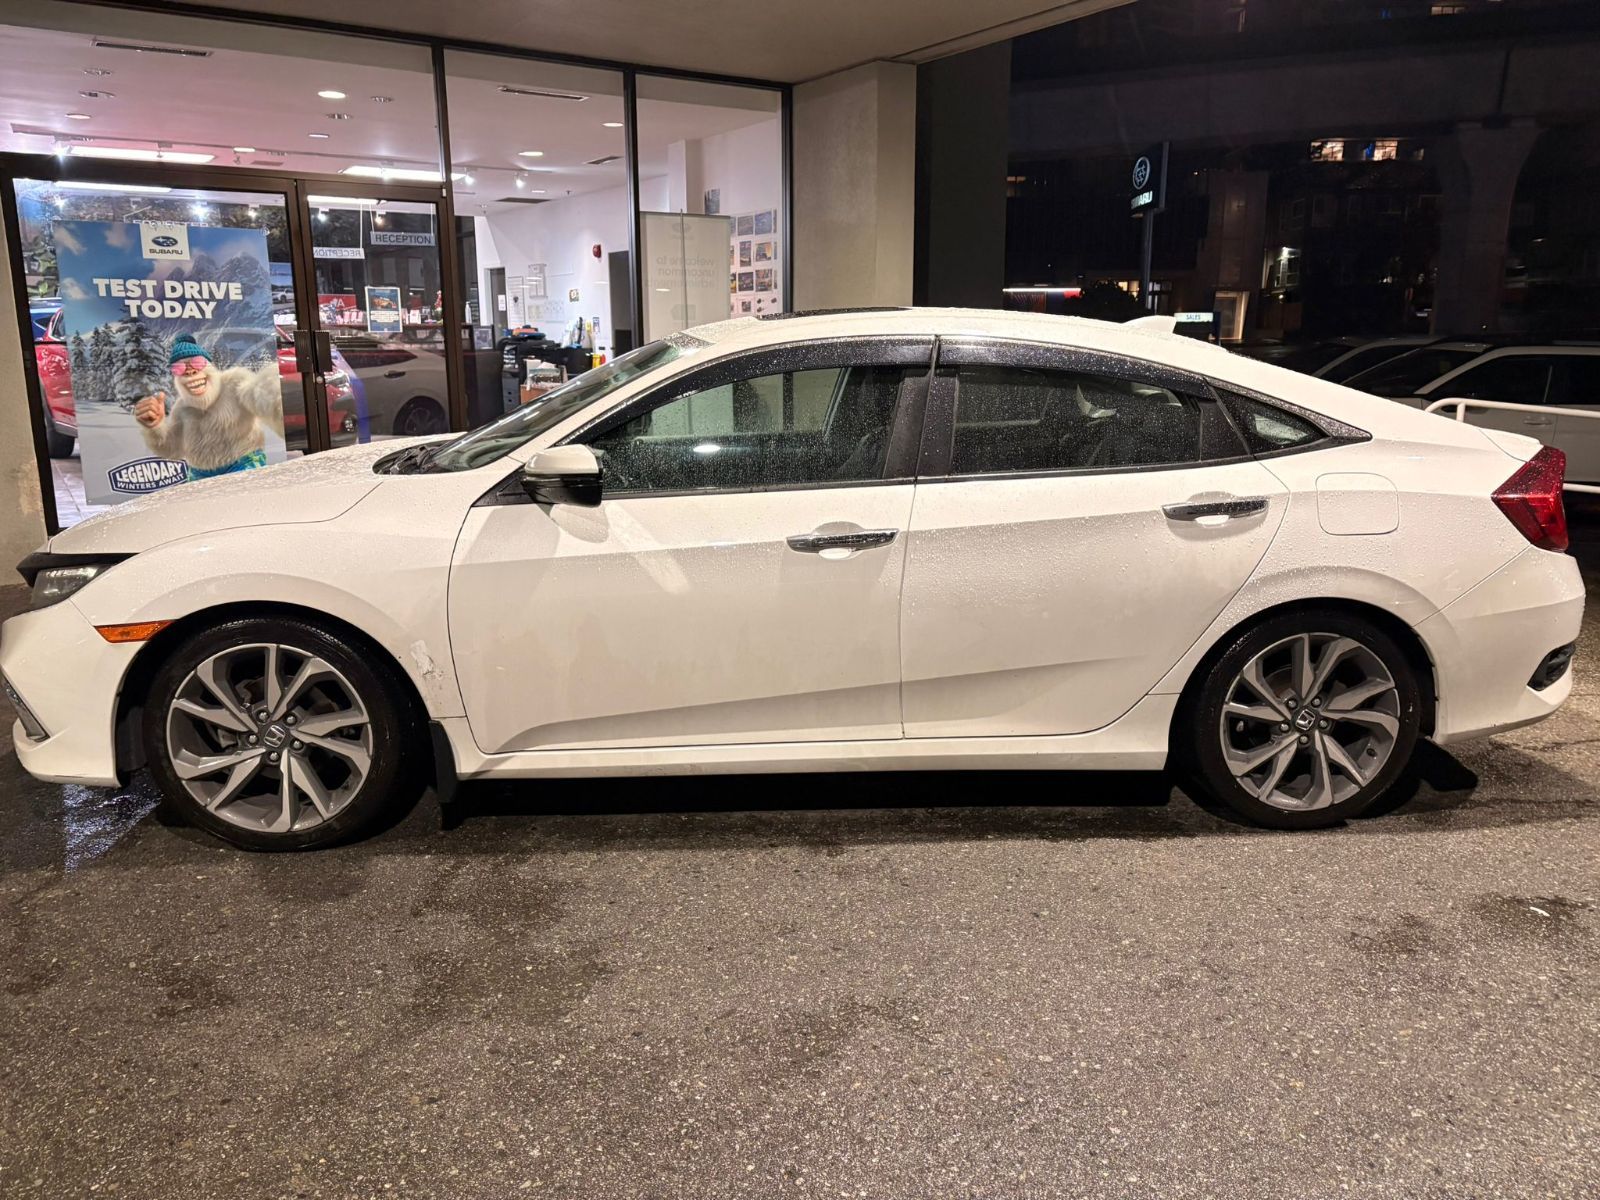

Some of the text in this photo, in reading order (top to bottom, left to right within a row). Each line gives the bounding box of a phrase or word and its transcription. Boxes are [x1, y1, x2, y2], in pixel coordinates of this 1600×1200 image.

[375, 234, 431, 244] RECEPTION
[92, 278, 243, 300] TEST DRIVE
[124, 299, 217, 319] TODAY
[115, 461, 182, 483] LEGENDARY
[117, 473, 184, 490] WINTERS AWAIT
